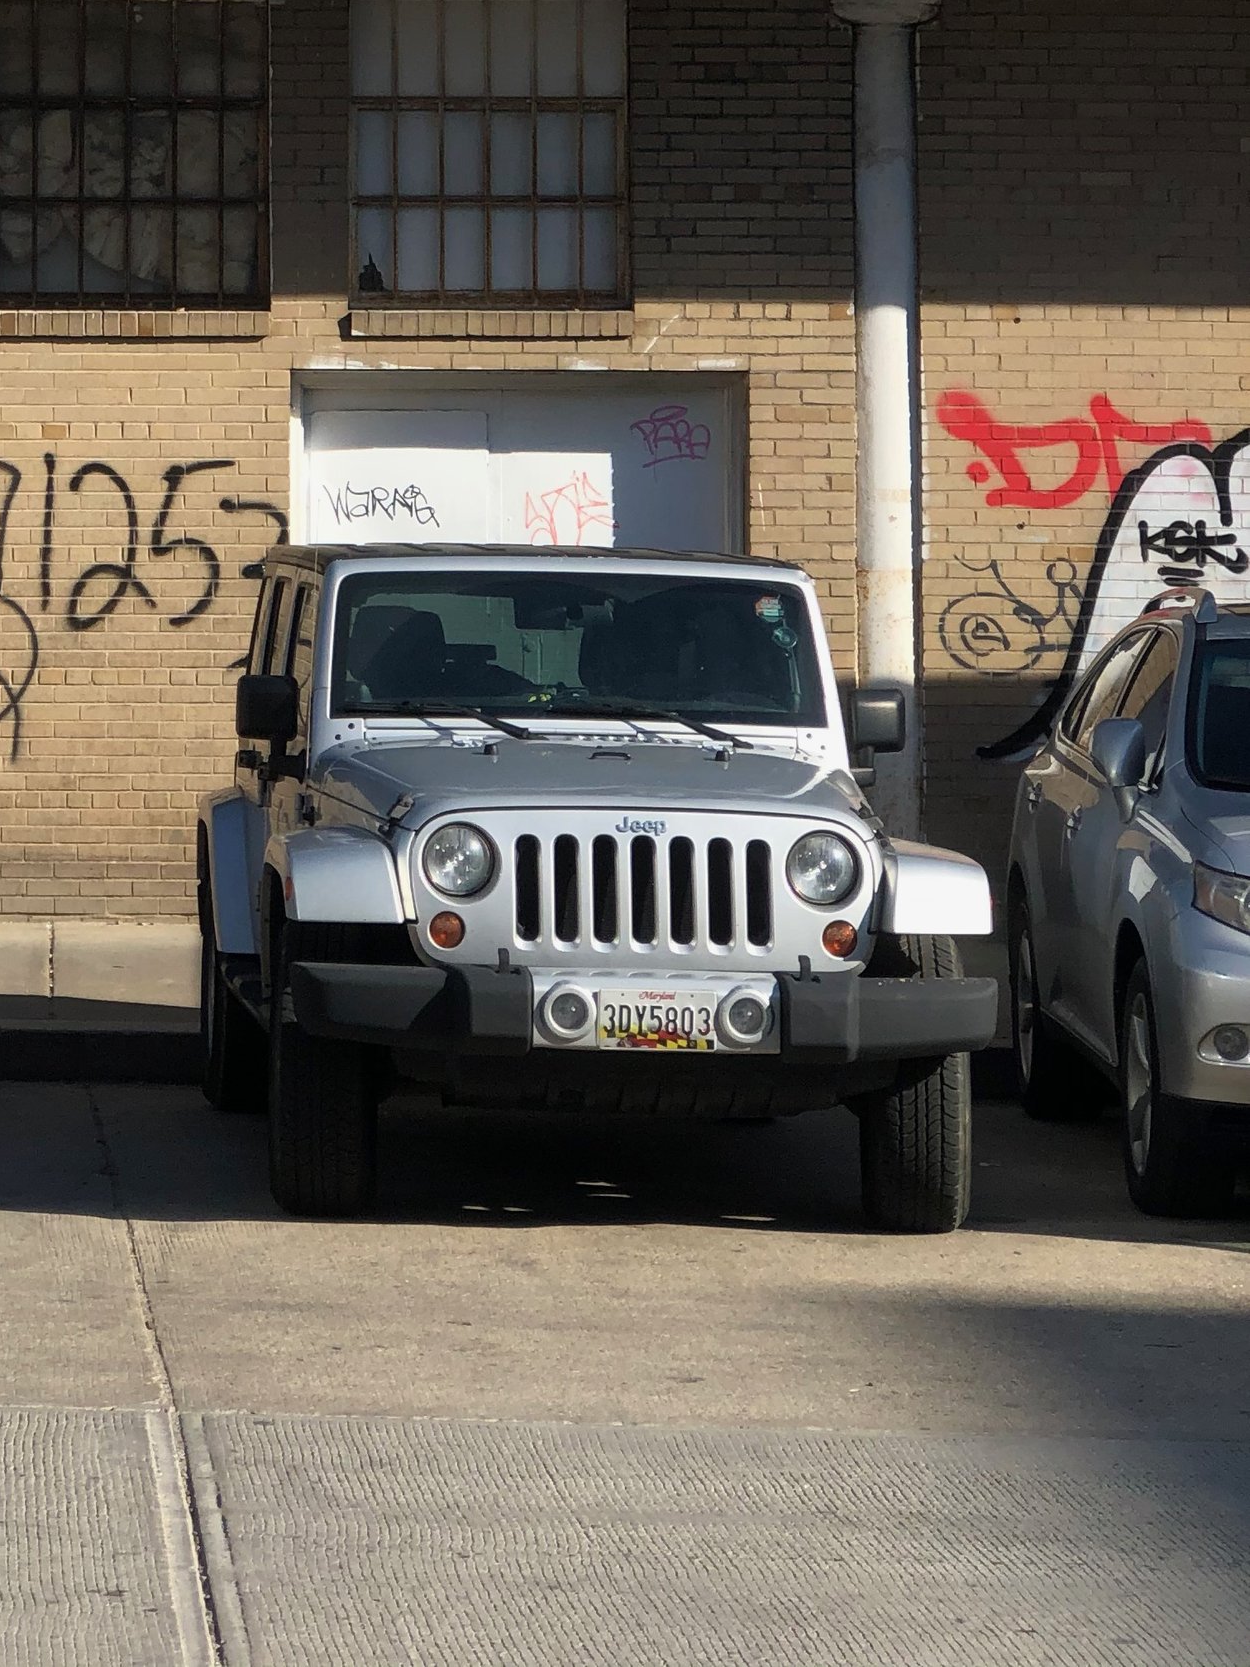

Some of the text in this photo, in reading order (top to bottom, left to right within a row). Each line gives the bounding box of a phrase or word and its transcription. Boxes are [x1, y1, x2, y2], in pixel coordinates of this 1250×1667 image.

[615, 816, 667, 837] Jeep
[638, 991, 677, 1003] Maryland
[603, 1003, 711, 1037] 3DY5803
